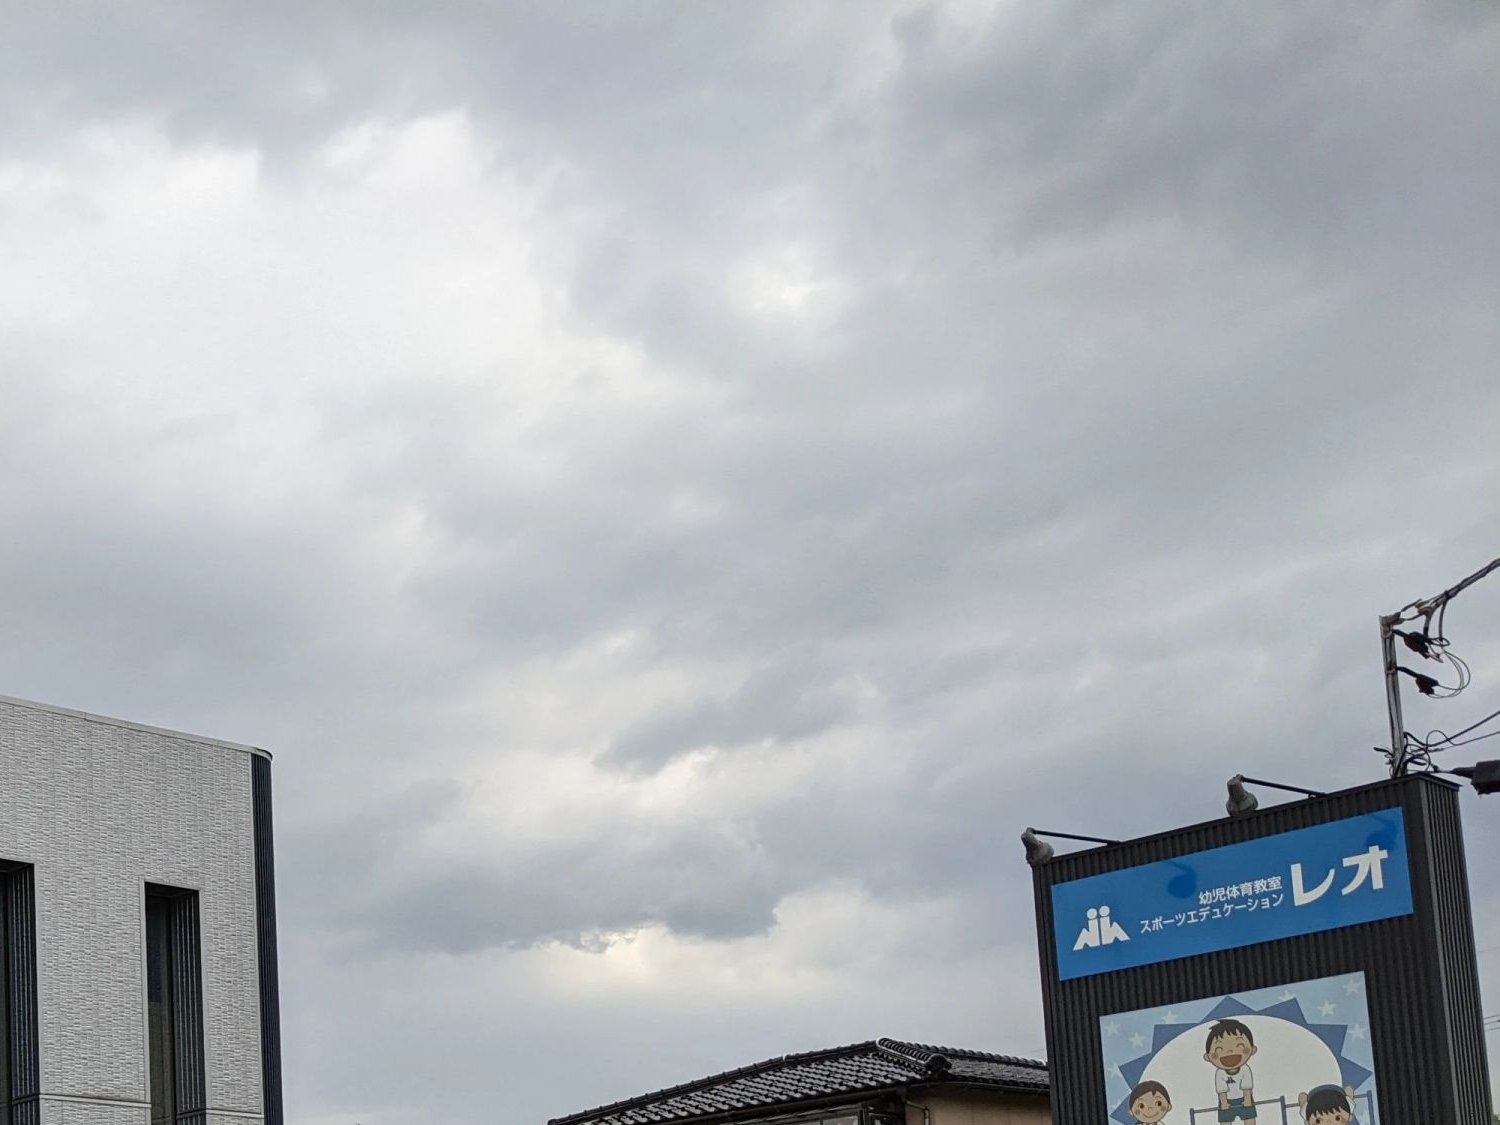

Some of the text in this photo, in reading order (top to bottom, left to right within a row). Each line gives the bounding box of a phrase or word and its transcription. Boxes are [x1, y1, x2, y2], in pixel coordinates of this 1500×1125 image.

[1198, 876, 1283, 905] 幼児体育教室
[1291, 845, 1388, 907] レオ
[1140, 893, 1285, 935] スポーツエデュケーション
